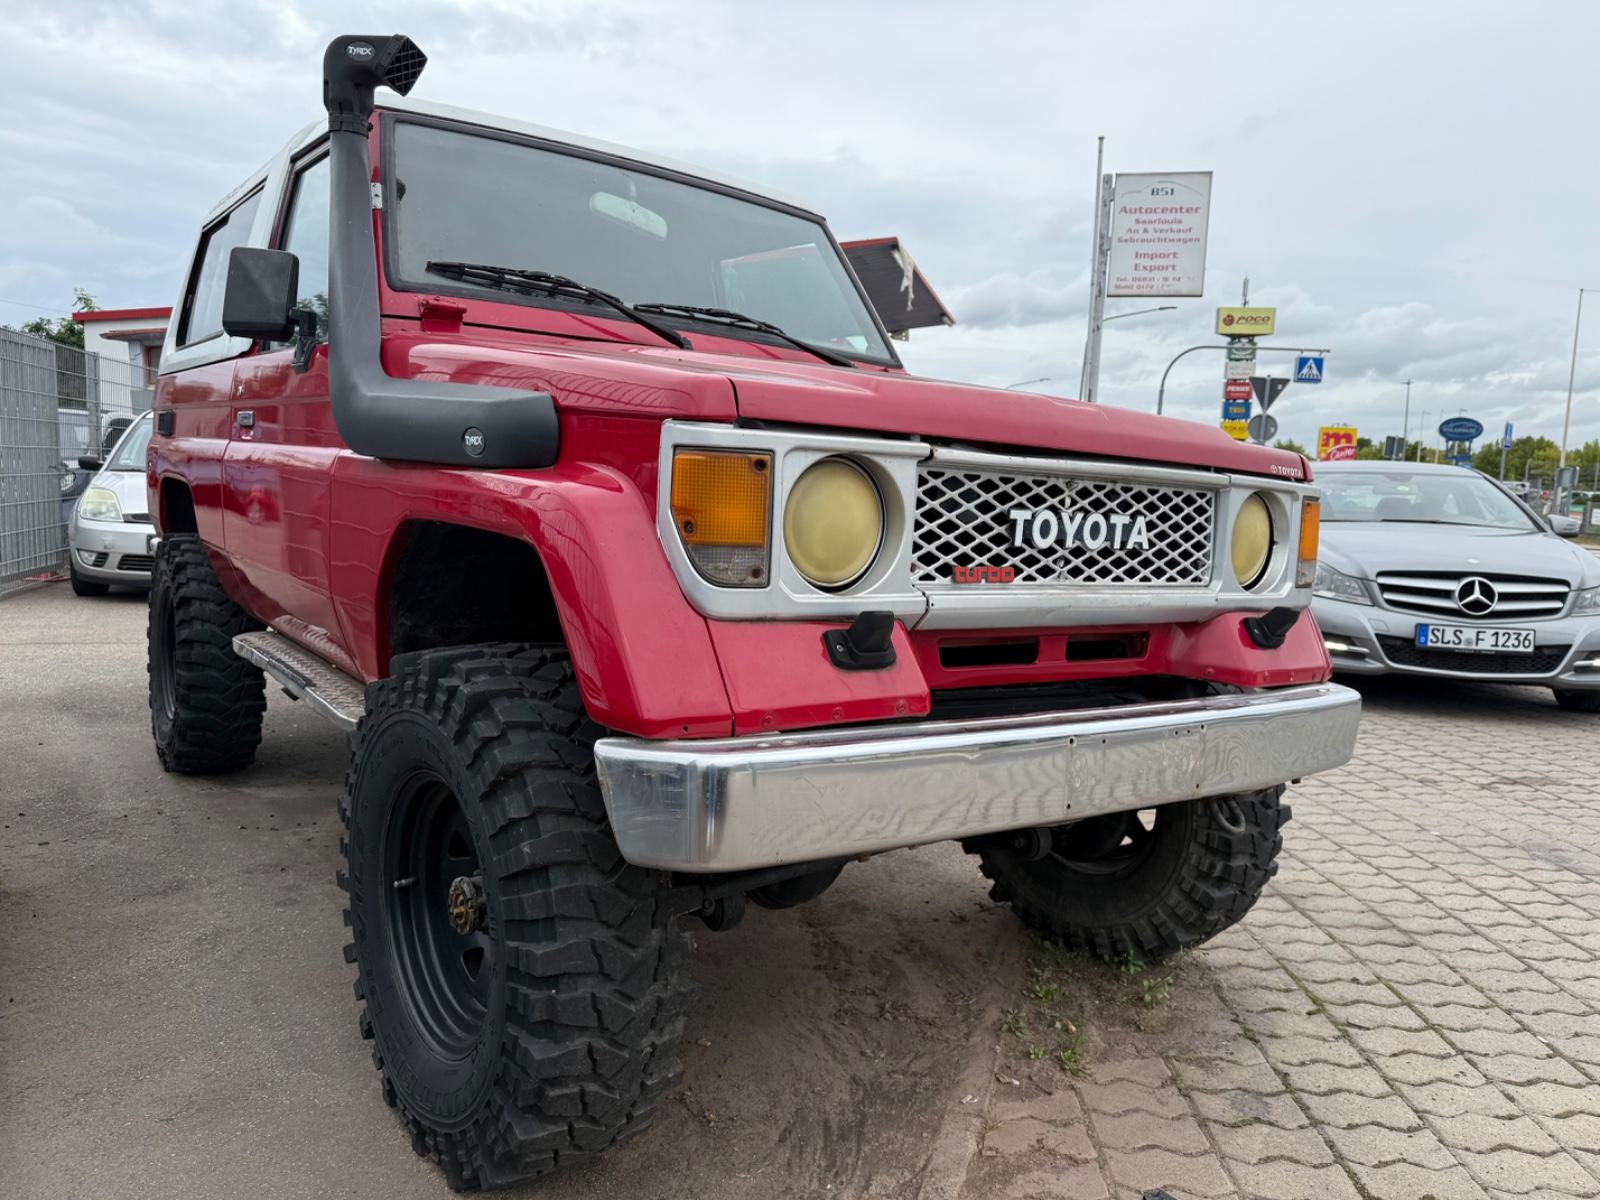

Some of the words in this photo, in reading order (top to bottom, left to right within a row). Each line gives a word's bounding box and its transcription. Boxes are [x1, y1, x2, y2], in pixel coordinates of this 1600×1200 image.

[347, 45, 372, 56] TYREX
[1119, 205, 1201, 215] Autocenter
[1134, 217, 1183, 225] Saarlouis
[1117, 236, 1201, 244] Gebrauchtwagen
[1134, 250, 1179, 260] Import
[1133, 263, 1178, 273] Export
[1235, 315, 1271, 324] POCO
[1277, 465, 1303, 477] TOYOTA
[1009, 508, 1150, 552] TOYOTA
[953, 566, 1016, 585] turbo
[1429, 627, 1464, 646] SLS
[1475, 630, 1487, 647] F
[1490, 631, 1532, 649] 1236
